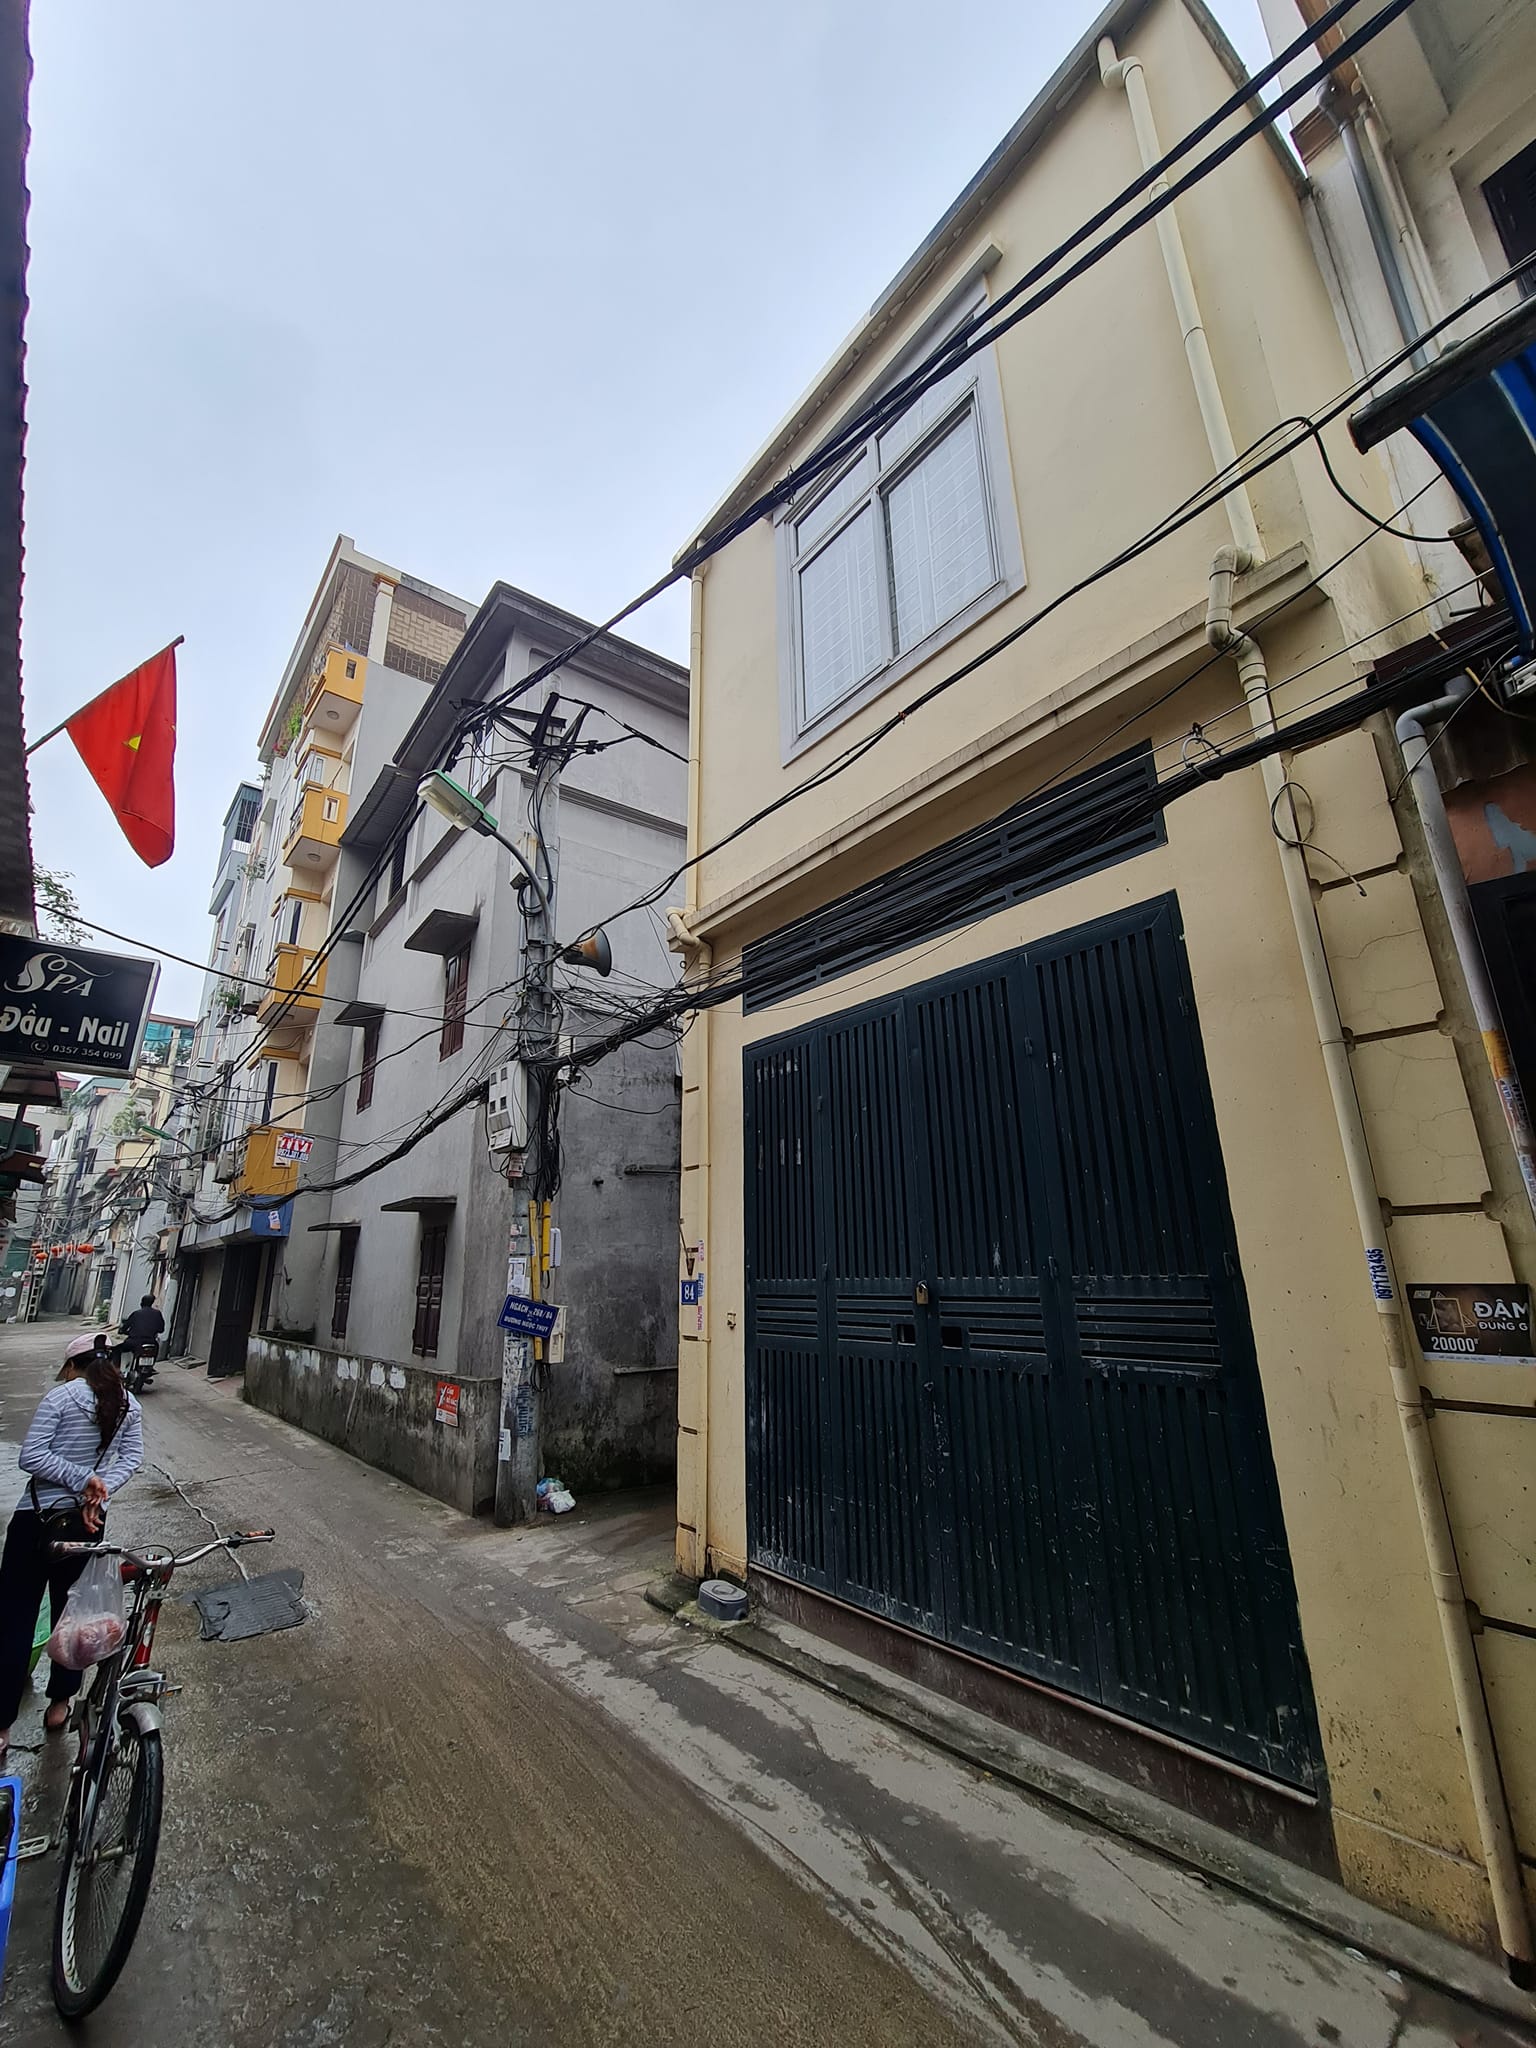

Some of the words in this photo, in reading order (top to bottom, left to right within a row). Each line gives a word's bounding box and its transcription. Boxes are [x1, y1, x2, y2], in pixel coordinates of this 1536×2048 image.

[77, 1016, 130, 1047] Nail
[52, 1044, 78, 1054] 0357
[81, 1047, 100, 1057] 354
[103, 1051, 122, 1060] 099
[684, 1284, 695, 1300] 84
